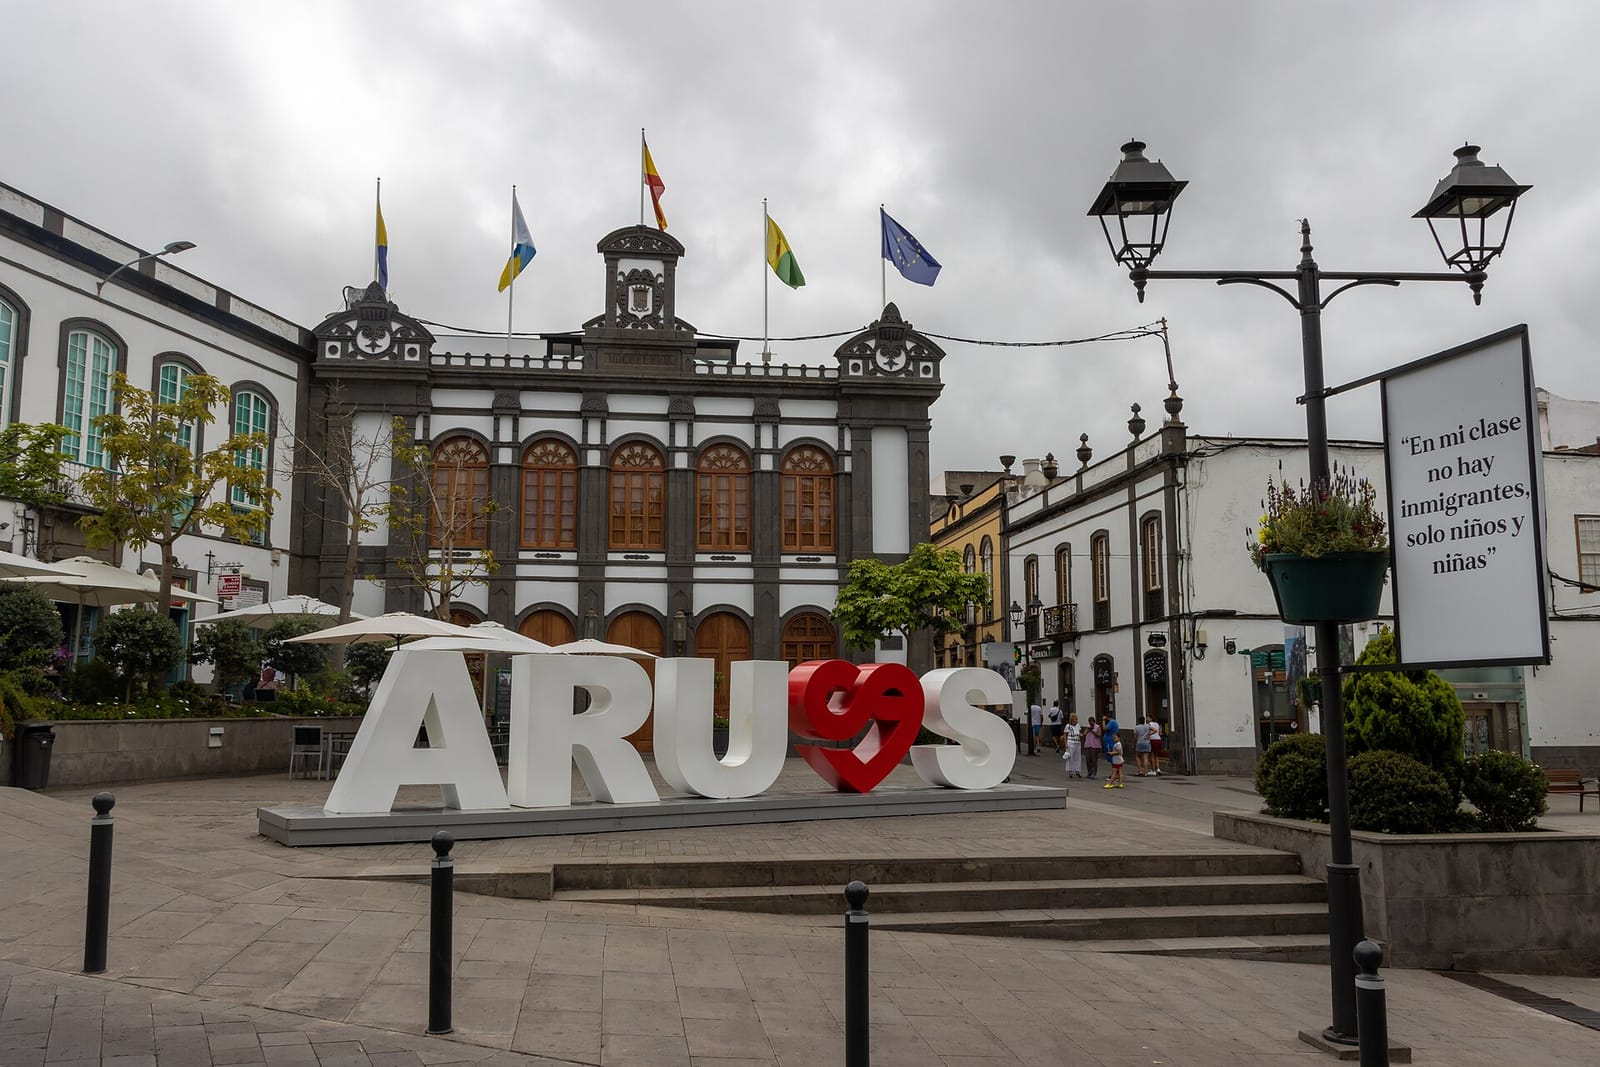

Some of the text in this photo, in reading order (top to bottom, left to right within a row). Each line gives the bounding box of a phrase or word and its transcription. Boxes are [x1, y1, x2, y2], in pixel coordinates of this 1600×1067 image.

[1401, 416, 1522, 456] “En mi clase
[1427, 455, 1495, 483] no hay
[1401, 482, 1531, 518] inmigrantes,
[1406, 515, 1526, 548] solo niños y
[1432, 546, 1497, 575] niñas”
